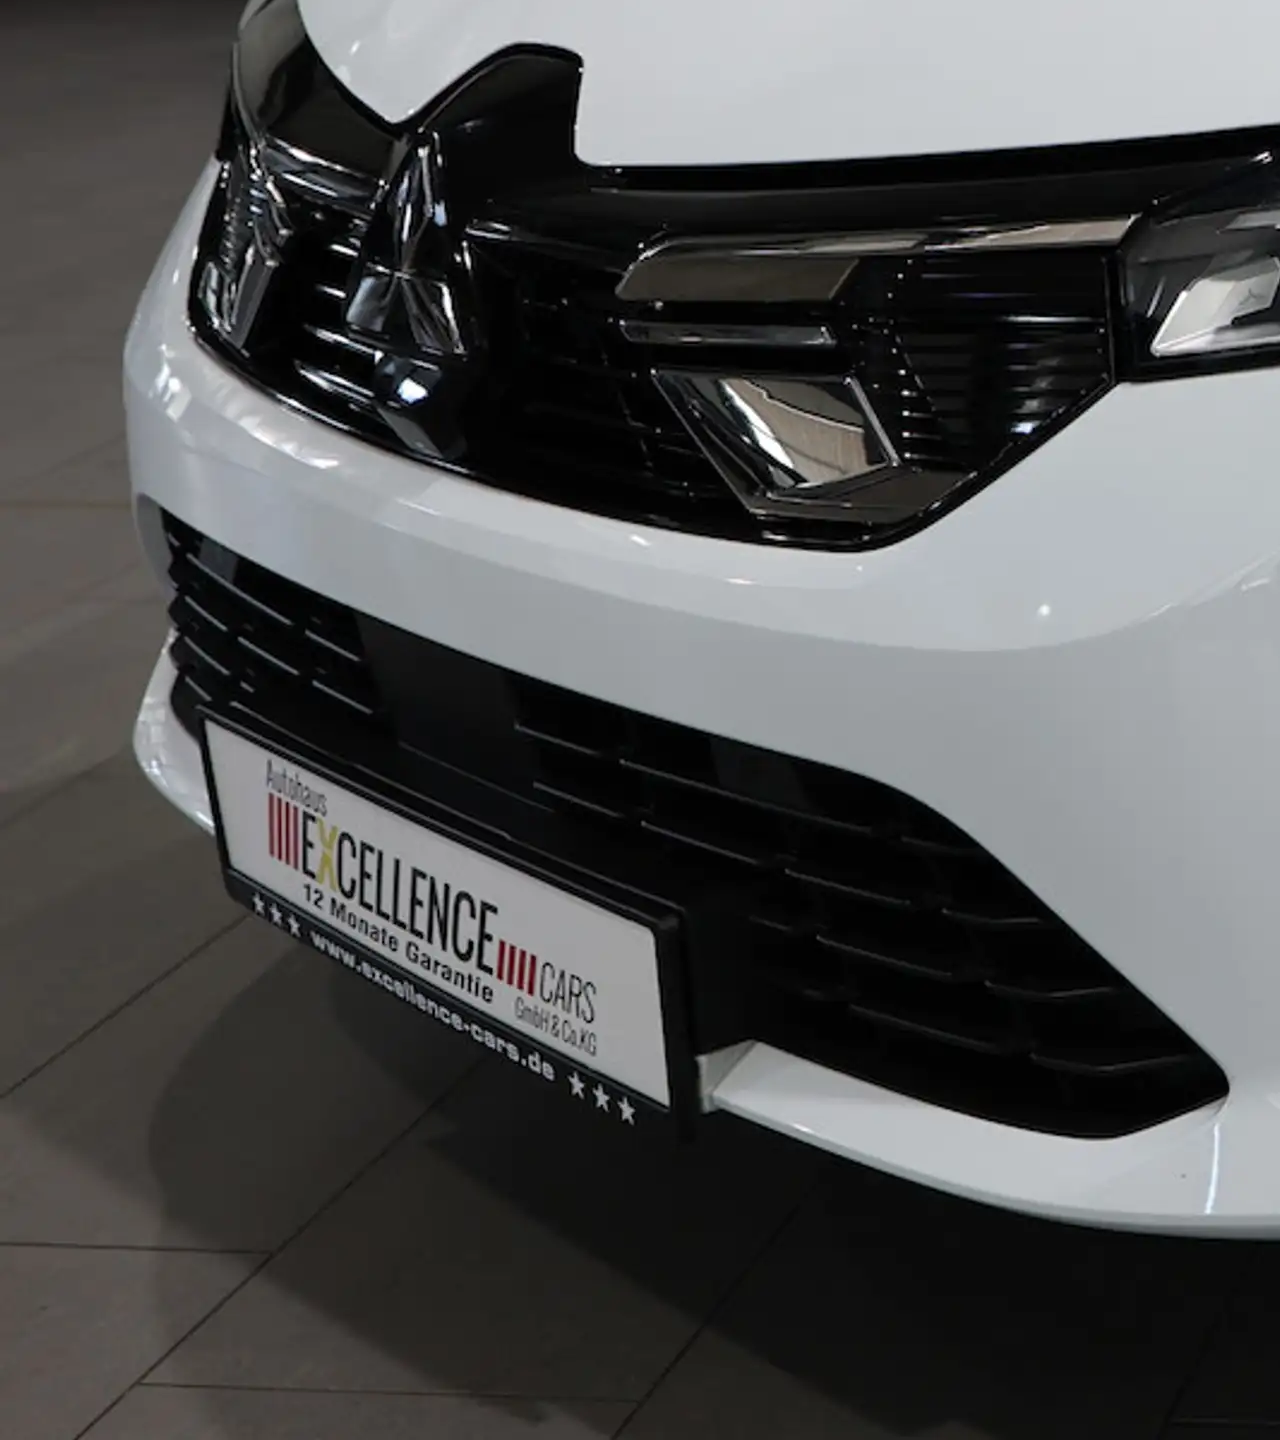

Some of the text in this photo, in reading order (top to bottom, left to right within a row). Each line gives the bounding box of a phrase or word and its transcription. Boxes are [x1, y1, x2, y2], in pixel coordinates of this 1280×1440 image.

[265, 759, 328, 817] Autohaus
[302, 812, 597, 1024] EXCELLENCE CARS
[302, 883, 495, 1004] 12 Monate Garantie
[309, 928, 557, 1081] www.excellence-cars.de
